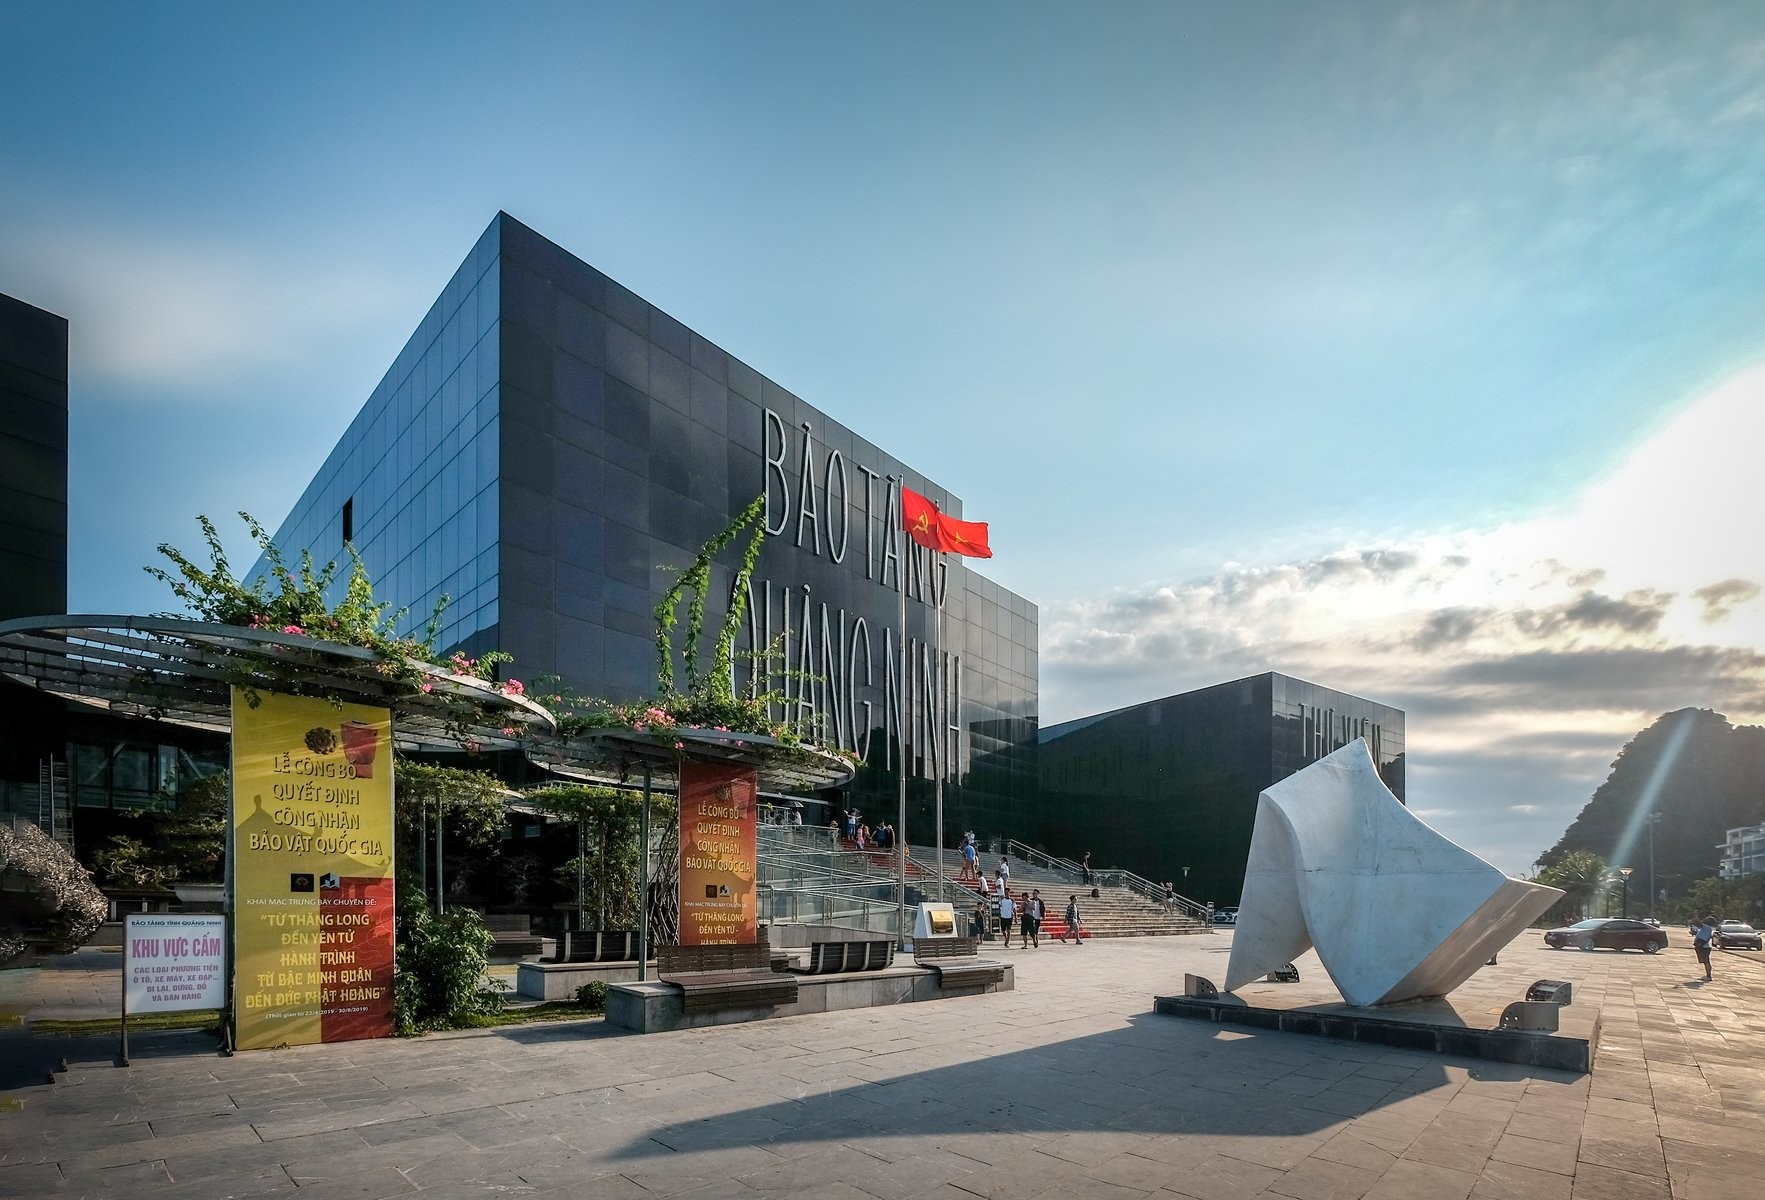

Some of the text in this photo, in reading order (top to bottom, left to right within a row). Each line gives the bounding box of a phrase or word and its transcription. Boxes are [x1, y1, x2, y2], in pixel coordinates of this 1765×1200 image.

[762, 406, 848, 564] BẢO
[730, 571, 962, 786] QUẢNG NINH
[1342, 715, 1381, 773] VN
[274, 751, 358, 780] LỄ CÔNG BỐ
[273, 781, 360, 807] QUYẾT ĐỊNH
[274, 807, 316, 827] CÔNG
[708, 804, 728, 818] CÔNG
[697, 820, 740, 839] QUYẾT ĐỊNH
[250, 829, 383, 856] BẢO VẬT QUỐC GIA
[697, 838, 718, 853] CÔNG
[703, 857, 717, 873] VẬT
[718, 855, 738, 872] QUỐC
[740, 861, 752, 873] GIA
[288, 912, 334, 927] THĂNG
[336, 914, 370, 926] LONG
[705, 911, 726, 921] THĂNG
[727, 913, 744, 921] LONG
[281, 929, 355, 945] ĐẾN YÊN TỬ
[699, 923, 712, 934] ĐẾN
[713, 925, 726, 934] YÊN
[132, 932, 221, 961] KHU VỰC CẤM
[280, 949, 356, 966] HÀNH TRÌNH
[257, 967, 372, 989] TỪ BẬC MINH QUÂN
[245, 990, 272, 1008] ĐẾN
[275, 989, 301, 1006] ĐỨC
[305, 988, 337, 1006] PHẬT
